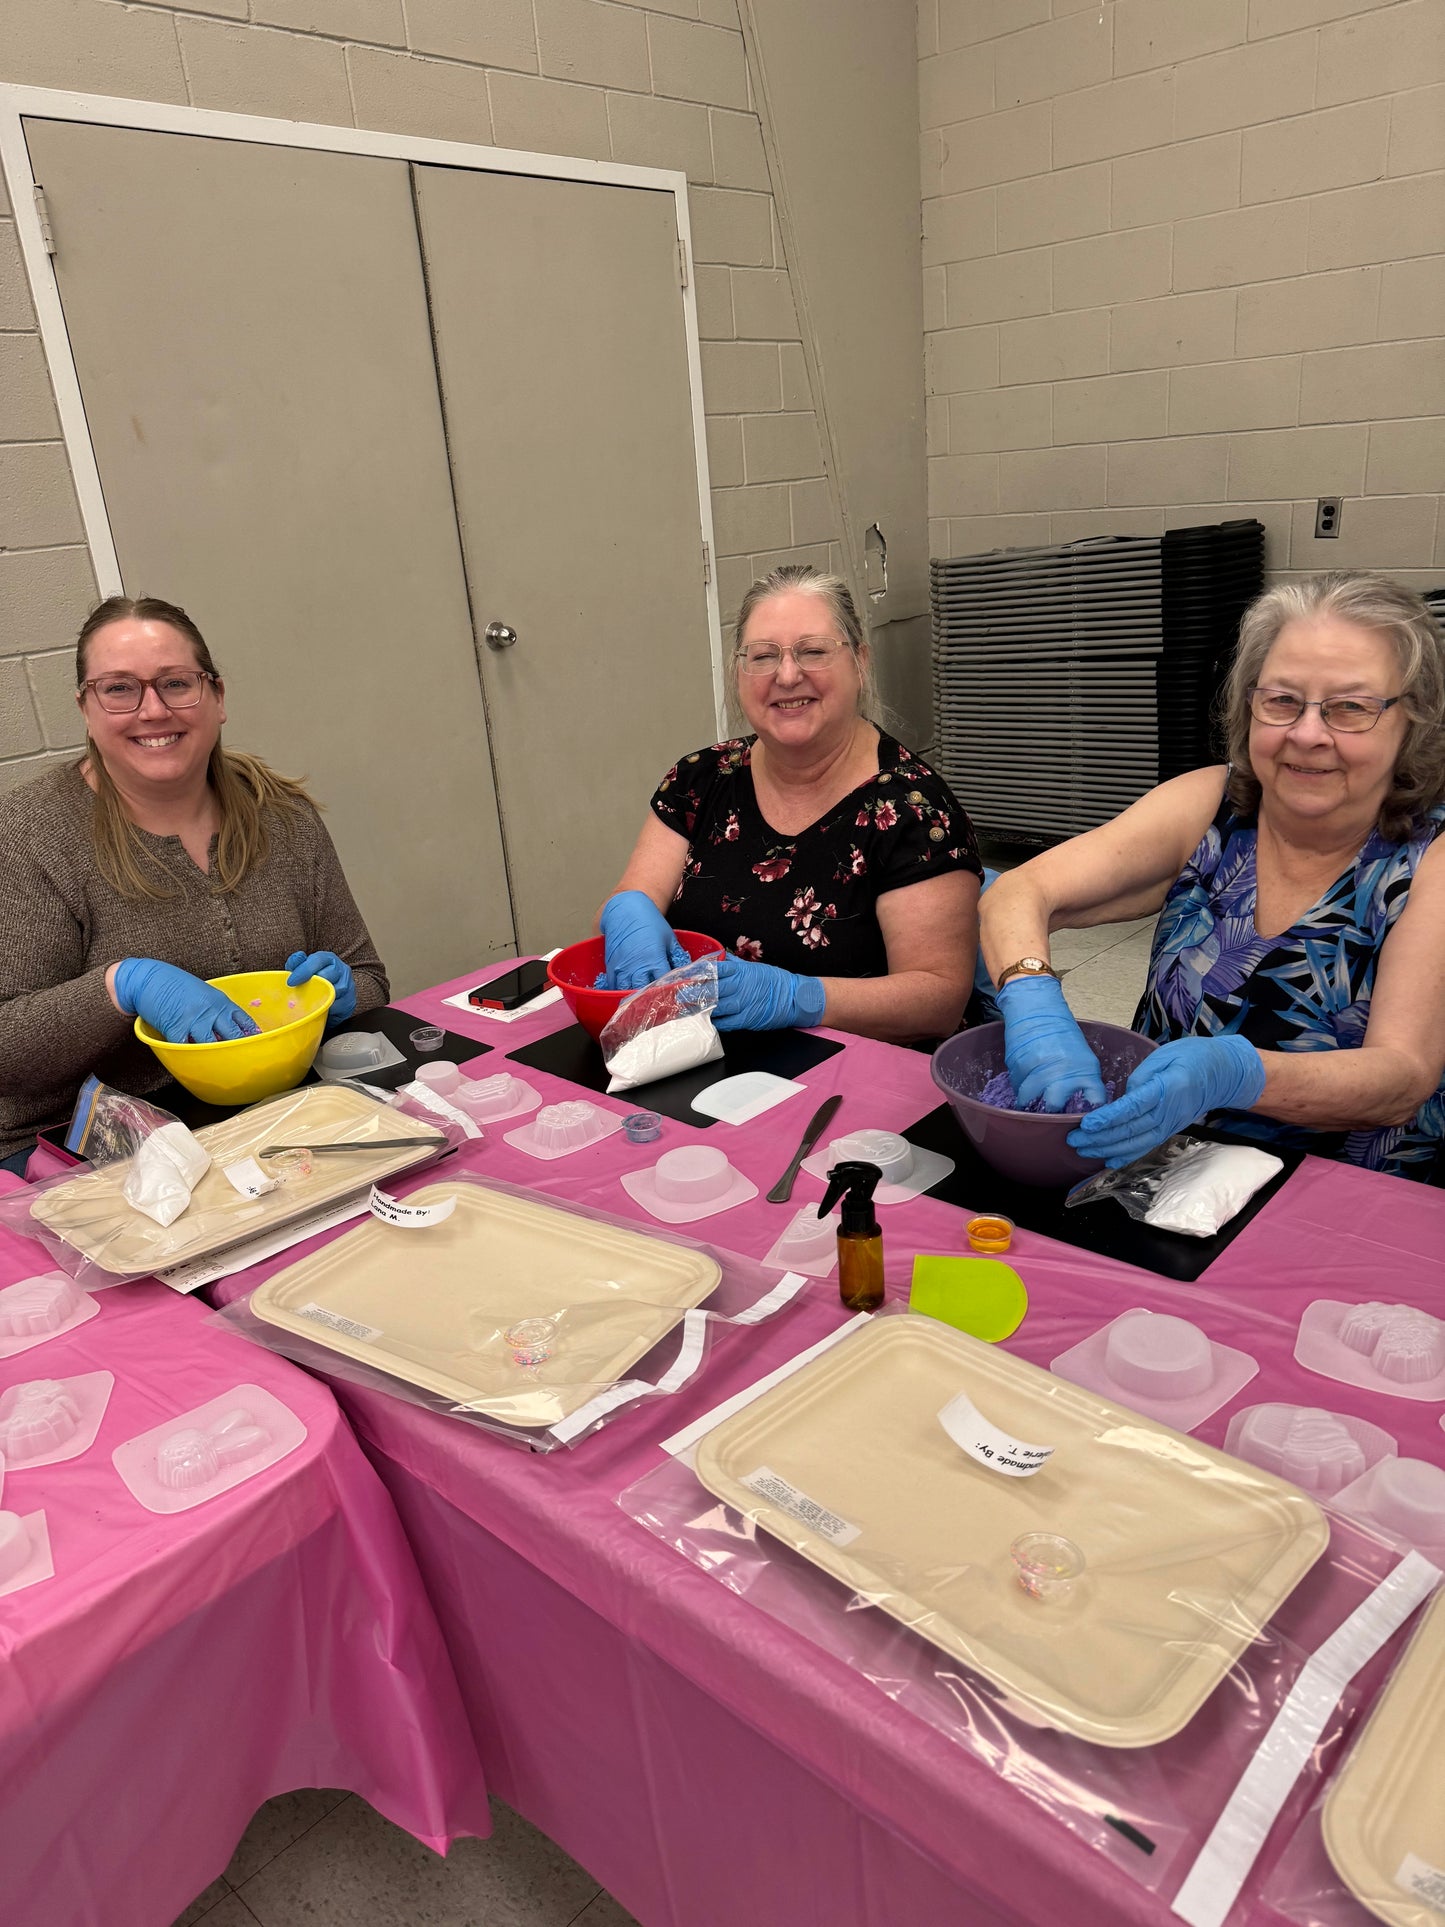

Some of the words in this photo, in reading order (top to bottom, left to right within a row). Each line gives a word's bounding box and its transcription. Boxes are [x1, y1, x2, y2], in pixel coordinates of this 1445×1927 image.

[373, 1192, 412, 1215] Handmade
[389, 1214, 401, 1222] M.
[975, 1443, 994, 1458] By:
[1008, 1444, 1017, 1455] T.
